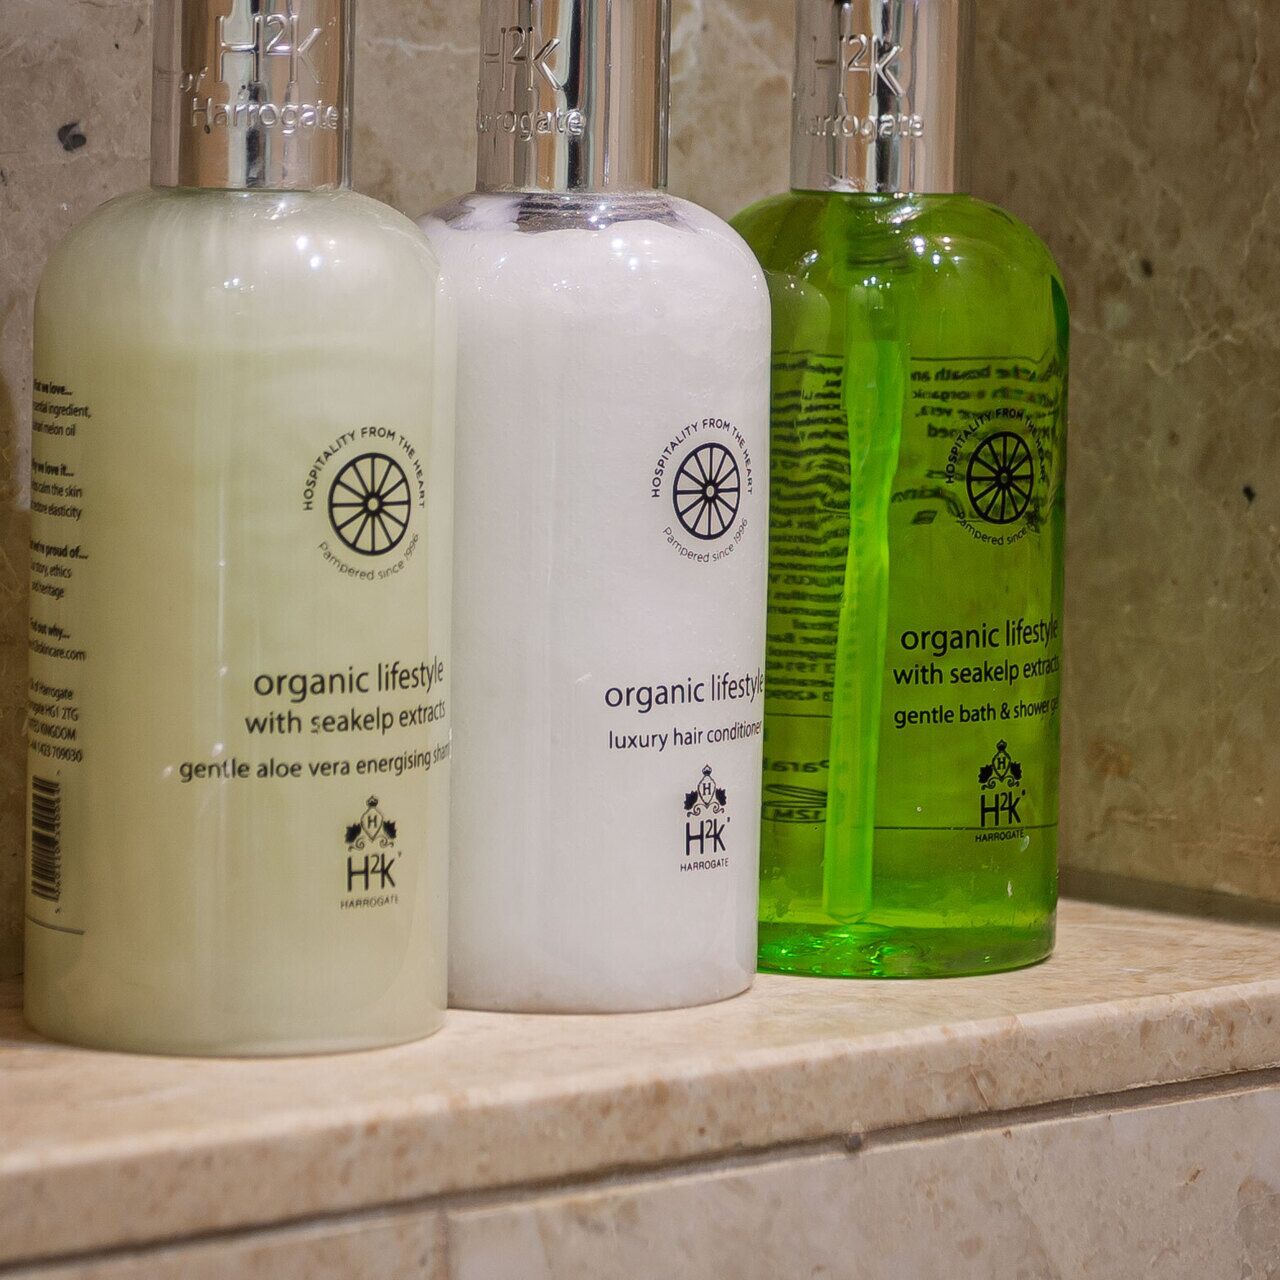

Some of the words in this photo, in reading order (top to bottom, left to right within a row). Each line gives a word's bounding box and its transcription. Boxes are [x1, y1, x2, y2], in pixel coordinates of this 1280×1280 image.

[191, 97, 340, 136] Harrogate
[651, 422, 698, 498] HOSPITALITY
[702, 418, 731, 431] FROM
[732, 426, 746, 449] THE
[742, 449, 753, 495] HEART
[945, 411, 992, 484] HOSPITALITY
[995, 408, 1025, 421] FROM
[303, 429, 356, 511] HOSPITALITY
[360, 426, 396, 439] FROM
[398, 435, 416, 460] THE
[412, 460, 426, 508] HEART
[662, 526, 710, 563] Pampered
[712, 543, 734, 562] since
[733, 517, 748, 545] 1996
[956, 510, 1005, 546] Pampered
[317, 540, 375, 581] Pampered
[377, 560, 405, 580] since
[403, 532, 420, 562] 1996
[900, 623, 1000, 658] organic
[1005, 613, 1058, 648] lifestyle
[254, 666, 370, 703] organic
[376, 656, 444, 694] lifestyle
[605, 677, 705, 714] organic
[711, 667, 764, 703] lifestyle
[892, 662, 944, 685] with
[950, 659, 1019, 686] seakelp
[245, 708, 303, 735] with
[310, 707, 395, 736] seakelp
[399, 699, 446, 728] extracts
[893, 704, 955, 729] gentle
[959, 703, 997, 723] bath
[1000, 702, 1011, 720] &
[1013, 699, 1049, 718] shower
[609, 730, 669, 752] luxury
[673, 728, 704, 746] hair
[179, 758, 250, 783] gentle
[256, 758, 303, 778] aloe
[308, 760, 351, 778] vera
[355, 749, 432, 777] energising
[975, 828, 1025, 843] HARROGATE
[680, 858, 729, 872] HARROGATE
[340, 894, 399, 910] HARROGATE
